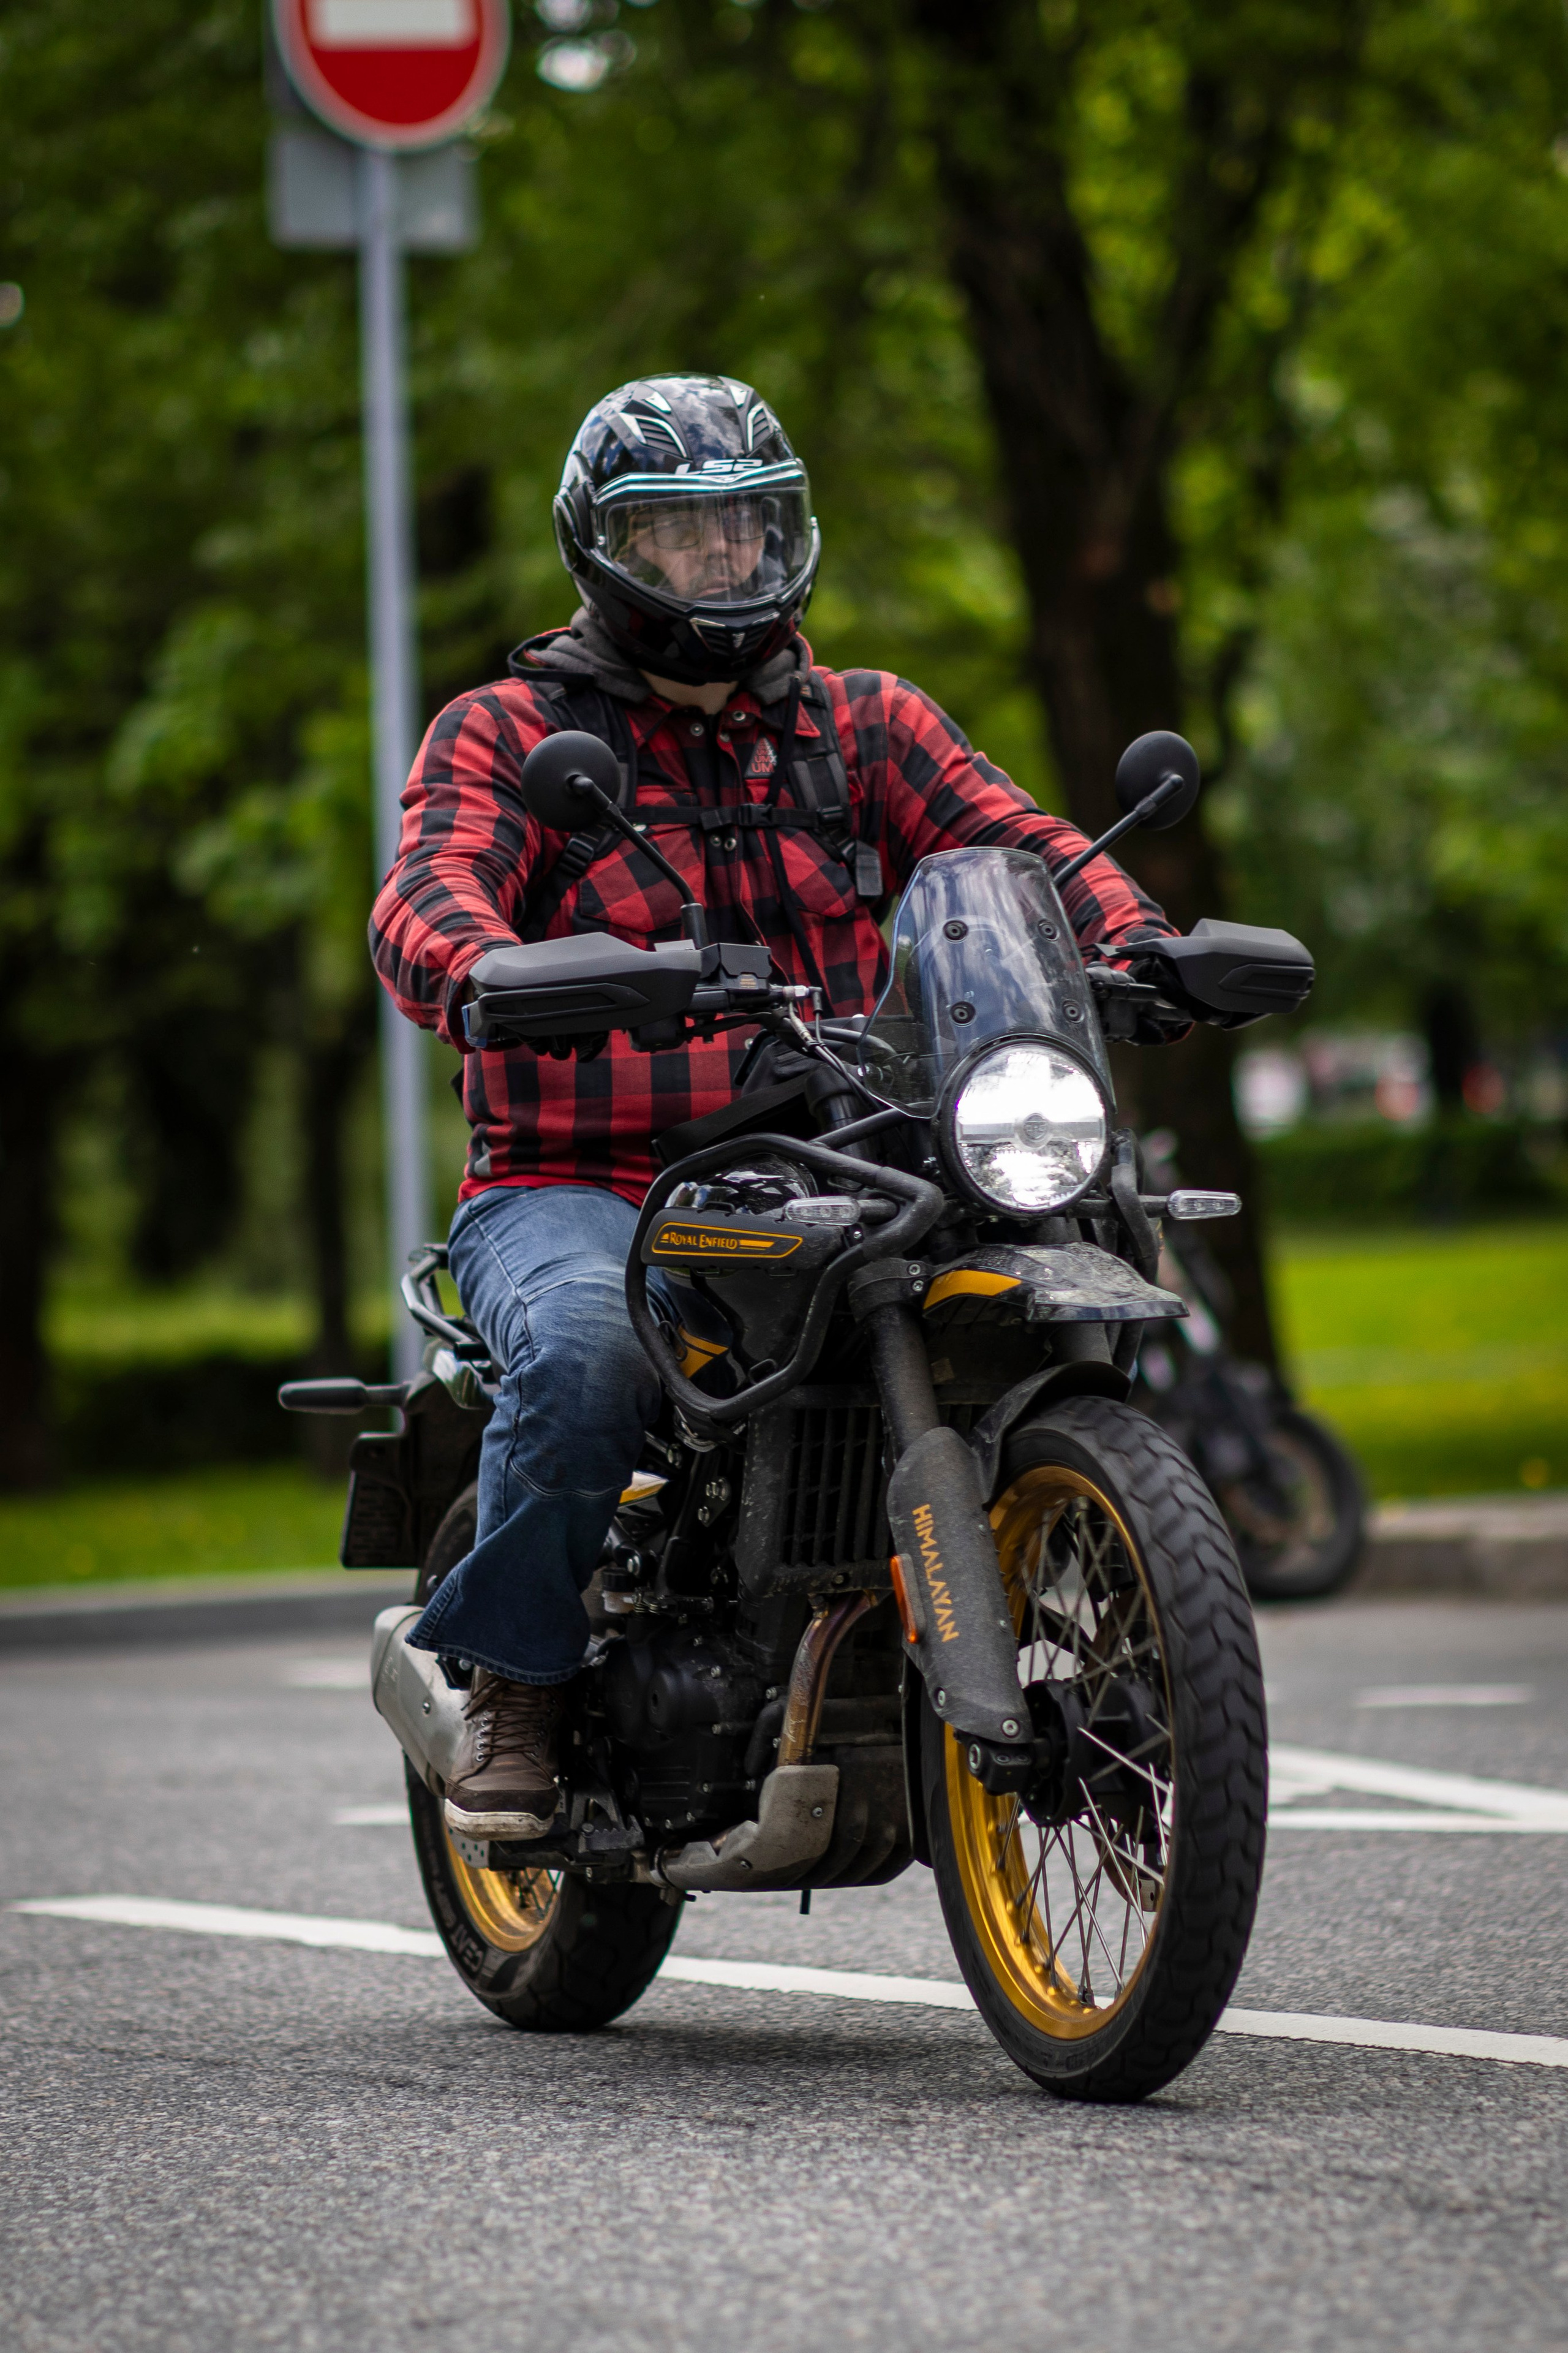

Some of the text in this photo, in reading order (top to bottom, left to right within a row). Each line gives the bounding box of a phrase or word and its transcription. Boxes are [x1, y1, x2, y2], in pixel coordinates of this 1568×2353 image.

[675, 459, 763, 475] LS2
[751, 763, 777, 773] UM
[912, 1504, 959, 1642] HIMALAYAN
